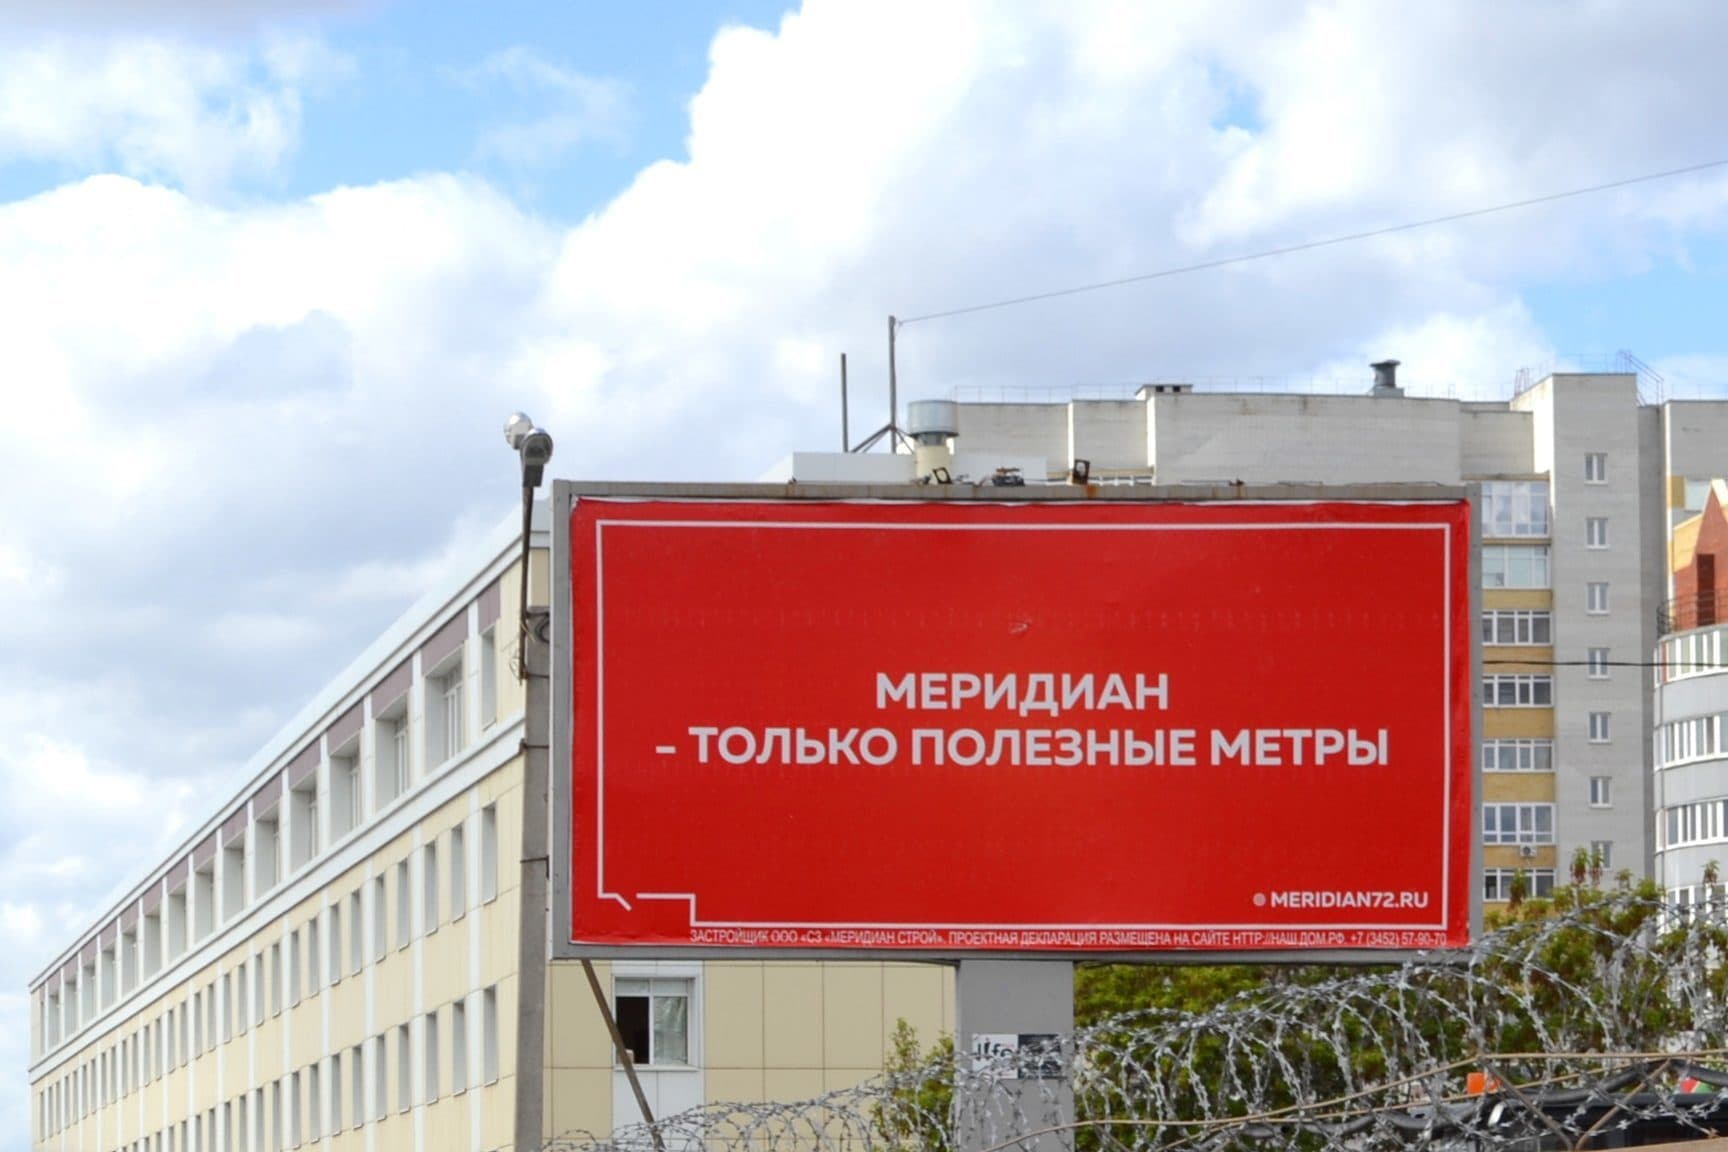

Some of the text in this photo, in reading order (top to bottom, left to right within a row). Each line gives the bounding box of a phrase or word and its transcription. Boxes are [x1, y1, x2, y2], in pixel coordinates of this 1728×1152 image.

[876, 672, 1168, 717] МЕРИДИАН
[688, 726, 898, 766] ТОЛЬКО
[912, 728, 1196, 766] ПОЛЕЗНЫЕ
[1210, 728, 1388, 766] МЕТРЫ
[1271, 891, 1428, 908] MERIDIAN72.RU
[690, 927, 769, 945] ЗАСТРОЙЩИК
[771, 929, 797, 944] ООО
[949, 931, 1018, 945] ПРОЕКТНАЯ
[1020, 931, 1097, 946] ДЕКЛАРАЦИЯ
[1099, 931, 1171, 946] РАЗМЕЩЕНА
[1174, 932, 1189, 945] НА
[1191, 929, 1229, 946] САЙТЕ
[1365, 932, 1400, 947] (3452)
[1401, 933, 1447, 945] 57-90-70
